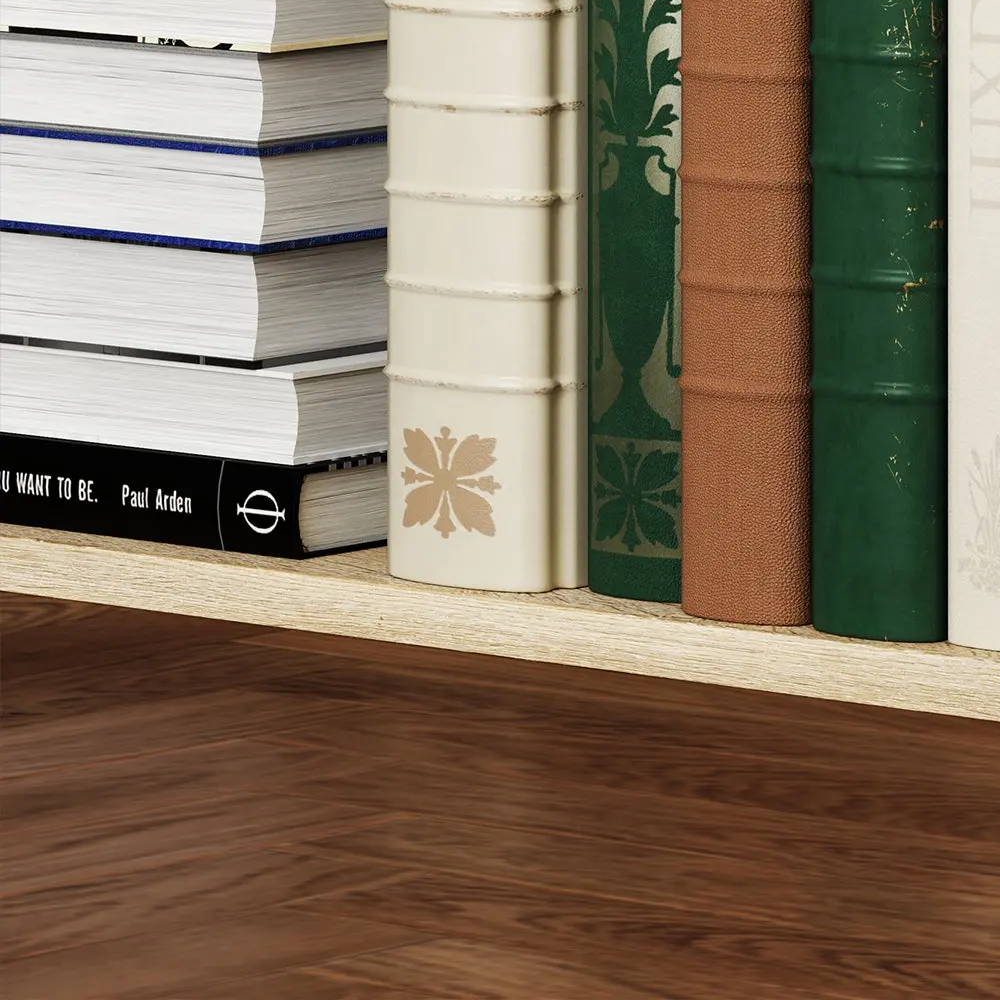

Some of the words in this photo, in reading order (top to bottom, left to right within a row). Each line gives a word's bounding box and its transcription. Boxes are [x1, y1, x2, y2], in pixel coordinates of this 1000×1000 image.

[15, 471, 51, 497] WANT
[57, 476, 72, 501] TO
[78, 479, 98, 503] BE.
[121, 484, 149, 509] Paul
[155, 489, 192, 514] Arden
